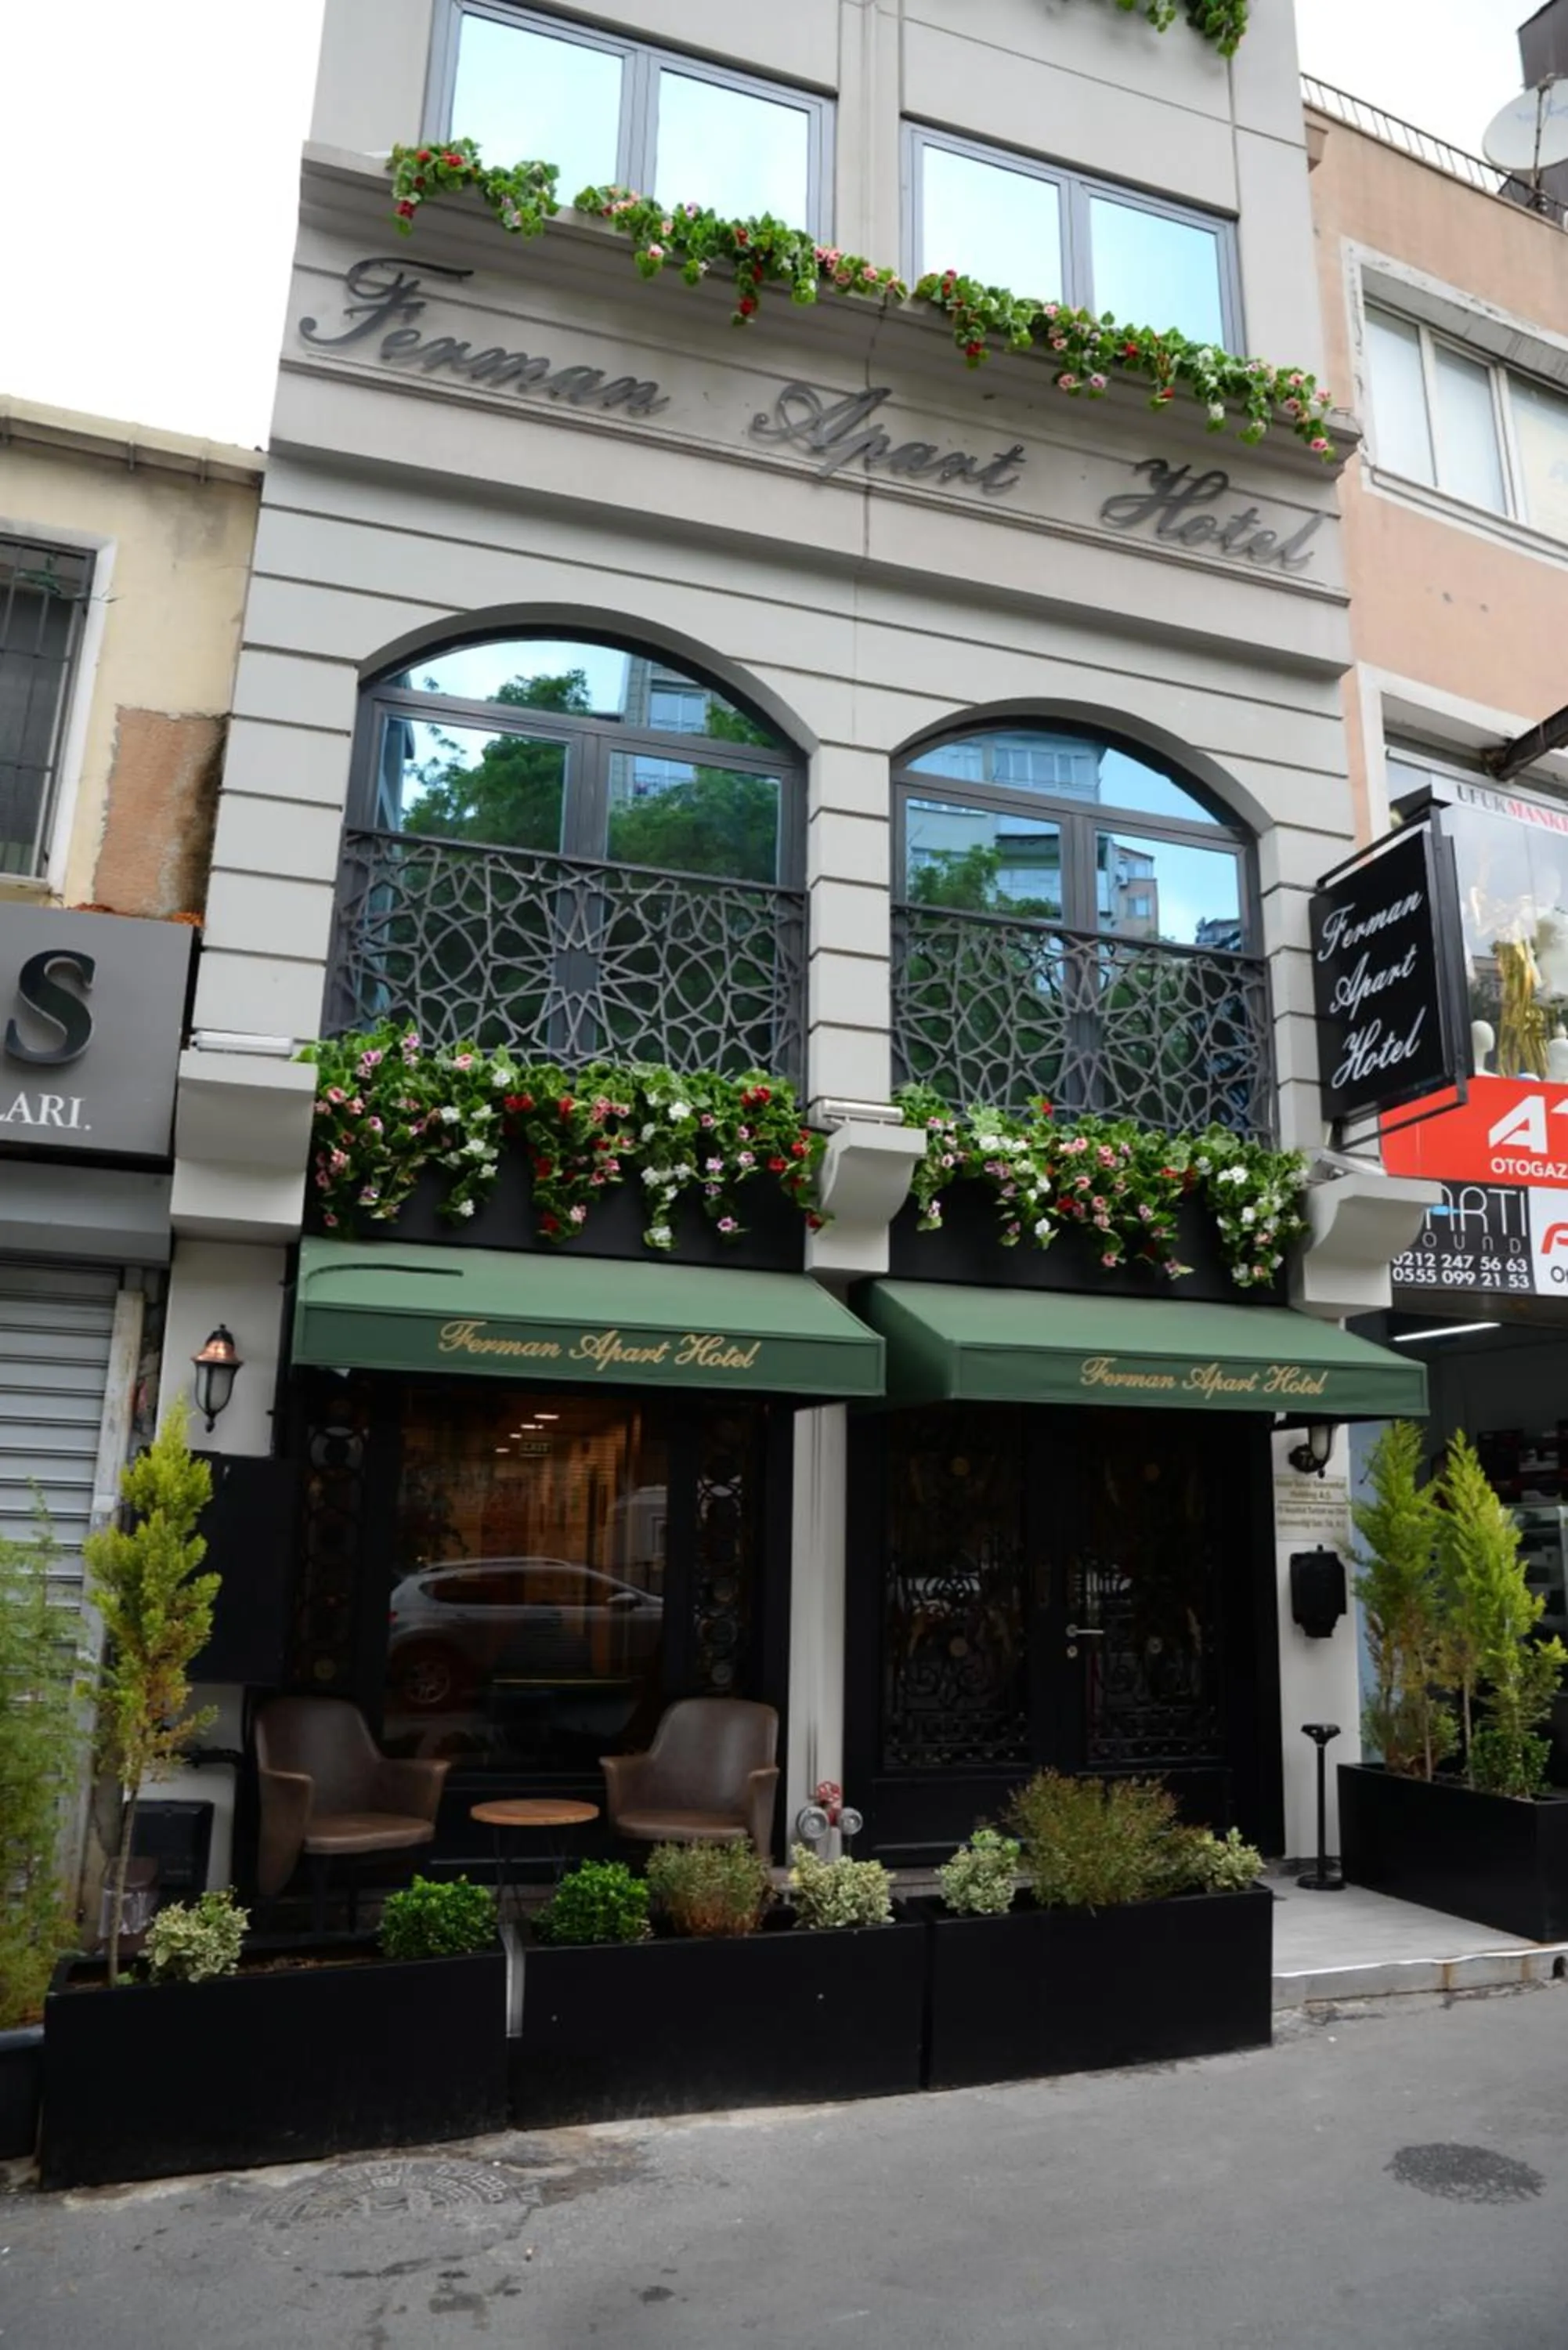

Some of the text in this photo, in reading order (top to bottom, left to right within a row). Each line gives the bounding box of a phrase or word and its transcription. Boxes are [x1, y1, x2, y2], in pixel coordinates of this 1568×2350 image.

[299, 257, 1330, 571] Ferman Apart Hotel
[1317, 890, 1425, 963] Ferman
[1330, 944, 1418, 1021] Apart
[1332, 1007, 1426, 1090] Hotel
[1488, 1095, 1568, 1154] A
[1490, 1157, 1568, 1180] OTOGAZ
[1392, 1251, 1527, 1273] 0212 247 56 63
[1422, 1231, 1522, 1254] OUND
[1392, 1267, 1530, 1289] 0555 099 21 53
[439, 1319, 762, 1372] Ferman Apart Hotel
[1080, 1356, 1329, 1399] Ferman Apart Hotel
